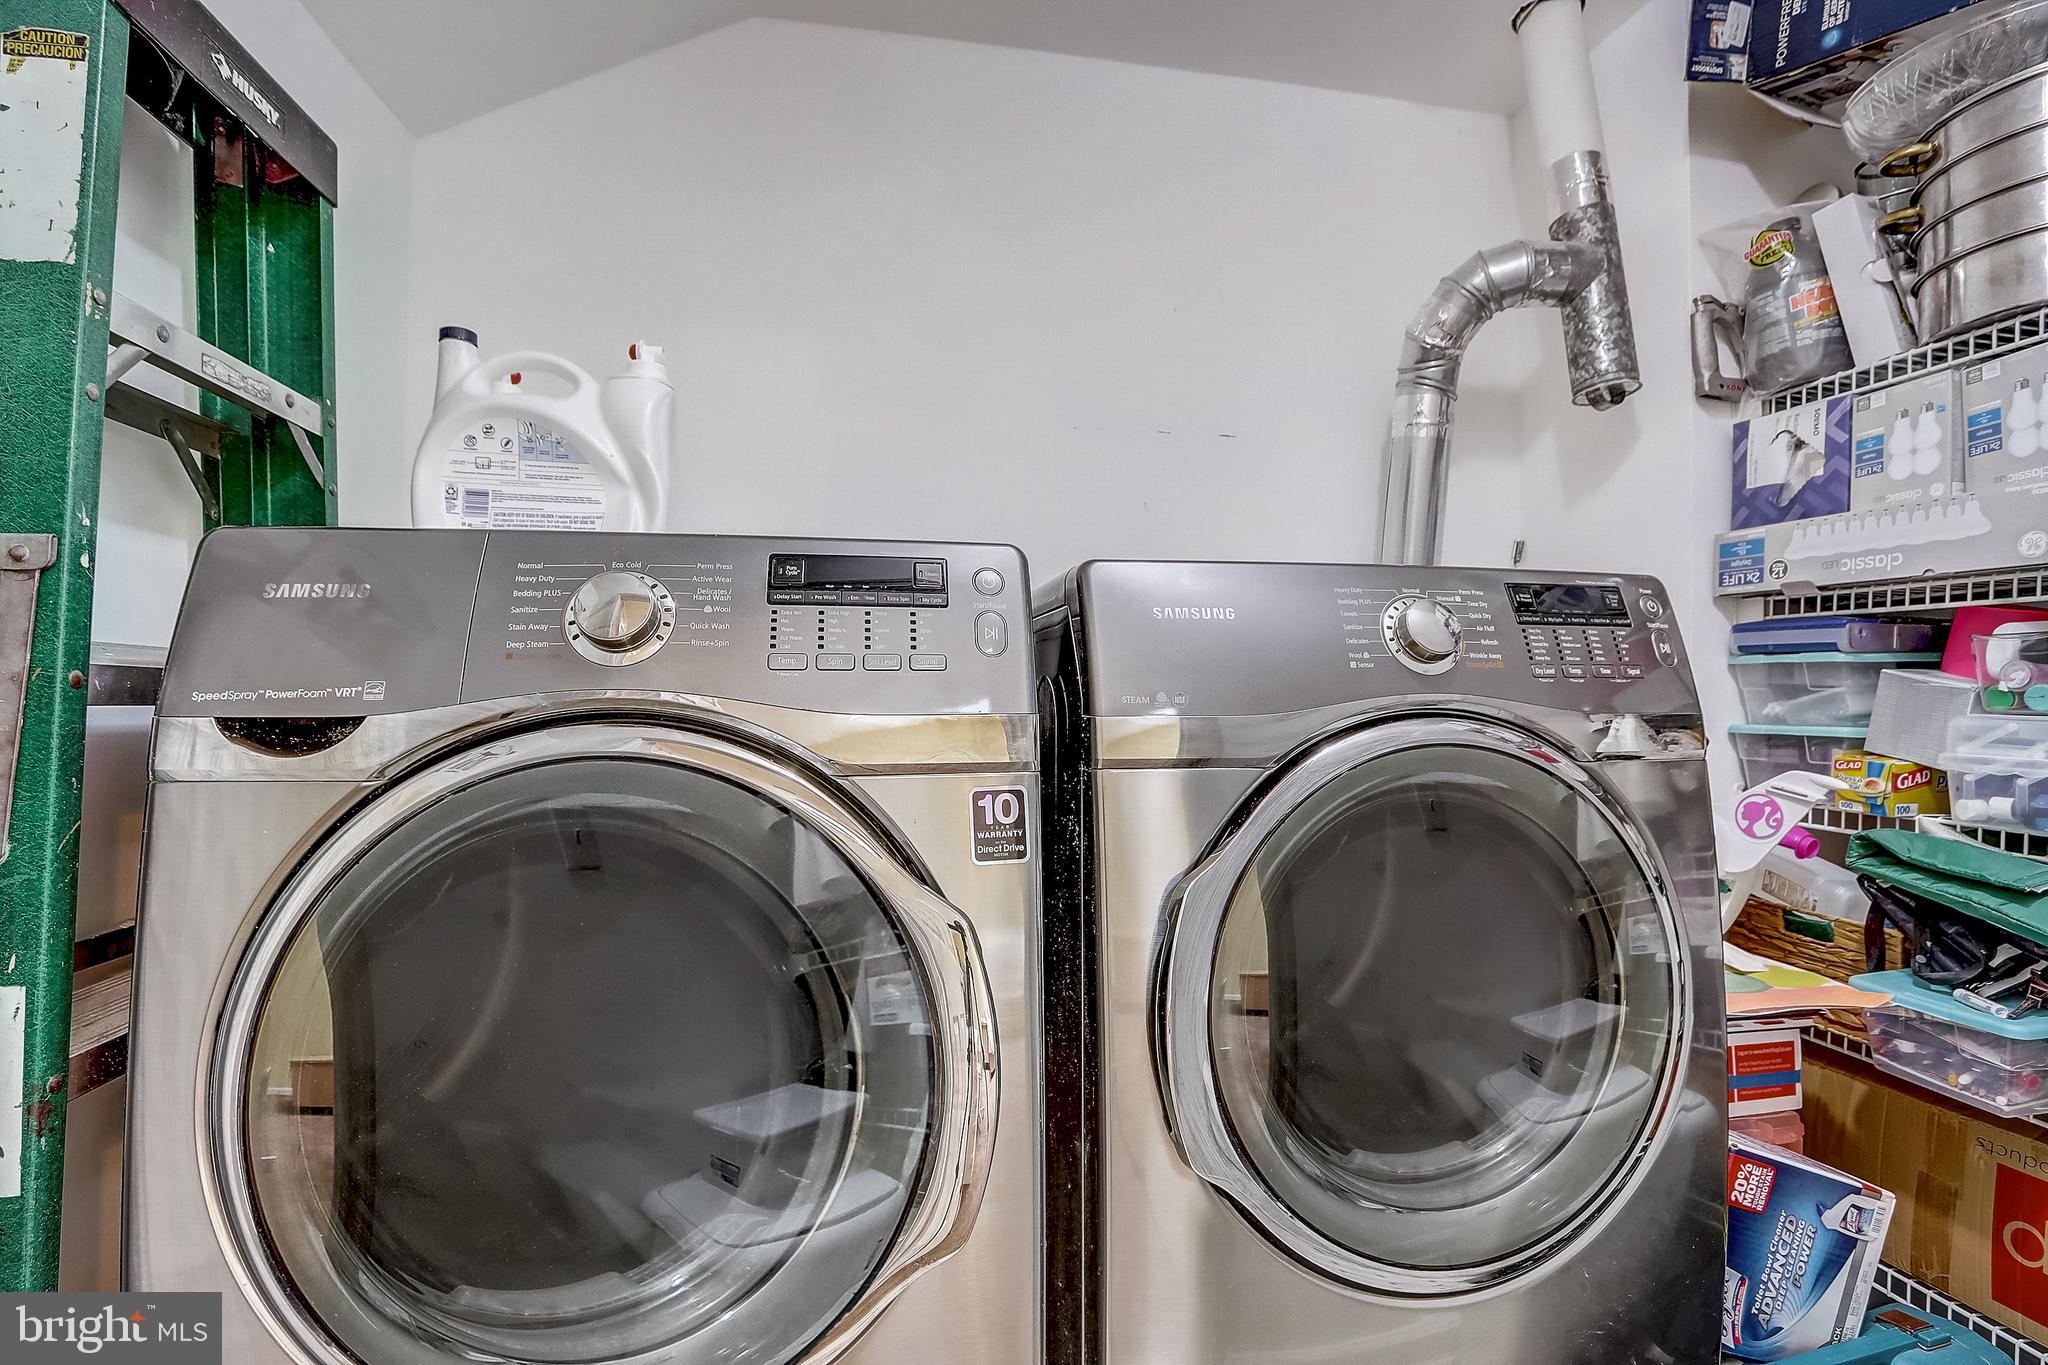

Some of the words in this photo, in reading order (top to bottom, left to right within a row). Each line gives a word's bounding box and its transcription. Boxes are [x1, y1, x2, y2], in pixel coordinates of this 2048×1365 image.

[20, 30, 76, 45] CAUTION
[6, 41, 84, 59] PRECAUCION
[231, 68, 281, 125] HUSKY
[1970, 444, 1989, 456] LIFE
[1990, 441, 2001, 449] 2x
[1856, 466, 1872, 477] LIFE
[1885, 488, 1922, 502] classic
[611, 561, 624, 569] Eco
[625, 561, 642, 569] Cold
[1821, 560, 1839, 569] LED
[1840, 552, 1903, 574] classic
[1747, 571, 1760, 583] 2x
[1771, 567, 1785, 579] 12
[515, 575, 536, 584] Heavy
[538, 575, 556, 583] Duty
[691, 575, 713, 583] Active
[714, 575, 733, 583] Wear
[1721, 573, 1745, 586] LIFE
[263, 583, 371, 599] SAMSUNG
[512, 590, 542, 598] Bedding
[543, 589, 562, 597] PLUS
[697, 587, 728, 595] Delicates
[692, 593, 711, 601] Hand
[510, 606, 539, 614] Sanitize
[712, 605, 731, 613] Wool
[1152, 607, 1236, 620] SAMSUNG
[508, 623, 527, 631] Stain
[527, 623, 549, 632] Away
[690, 622, 710, 630] Quick
[710, 622, 731, 630] Wash
[506, 640, 525, 649] Deep
[526, 640, 549, 648] Steam
[691, 639, 730, 648] Rinse+Spin
[827, 657, 843, 666] Spin
[868, 657, 880, 666] Soil
[1120, 695, 1150, 704] STEAM
[1835, 760, 1862, 769] GLAD
[1896, 769, 1931, 789] GLAD
[977, 792, 1020, 825] 10
[1840, 801, 1853, 809] 100
[1896, 805, 1911, 814] 100
[977, 829, 1023, 839] WARRANTY
[977, 844, 1002, 854] Direct
[1003, 843, 1025, 852] Drive
[1730, 1163, 1753, 1203] 20%
[1743, 1165, 1763, 1207] MORE
[1751, 1186, 1762, 1208] TOUGH
[1758, 1168, 1768, 1187] STAIN
[1791, 1223, 1818, 1288] POWER
[1751, 1283, 1766, 1315] Toilet
[1761, 1252, 1774, 1282] Bowl
[1770, 1209, 1787, 1252] Cleaner
[1774, 1278, 1789, 1311] DEEP
[1784, 1219, 1807, 1278] CLEANING
[1757, 1214, 1798, 1331] ADVANCED
[1832, 1326, 1843, 1345] ACK
